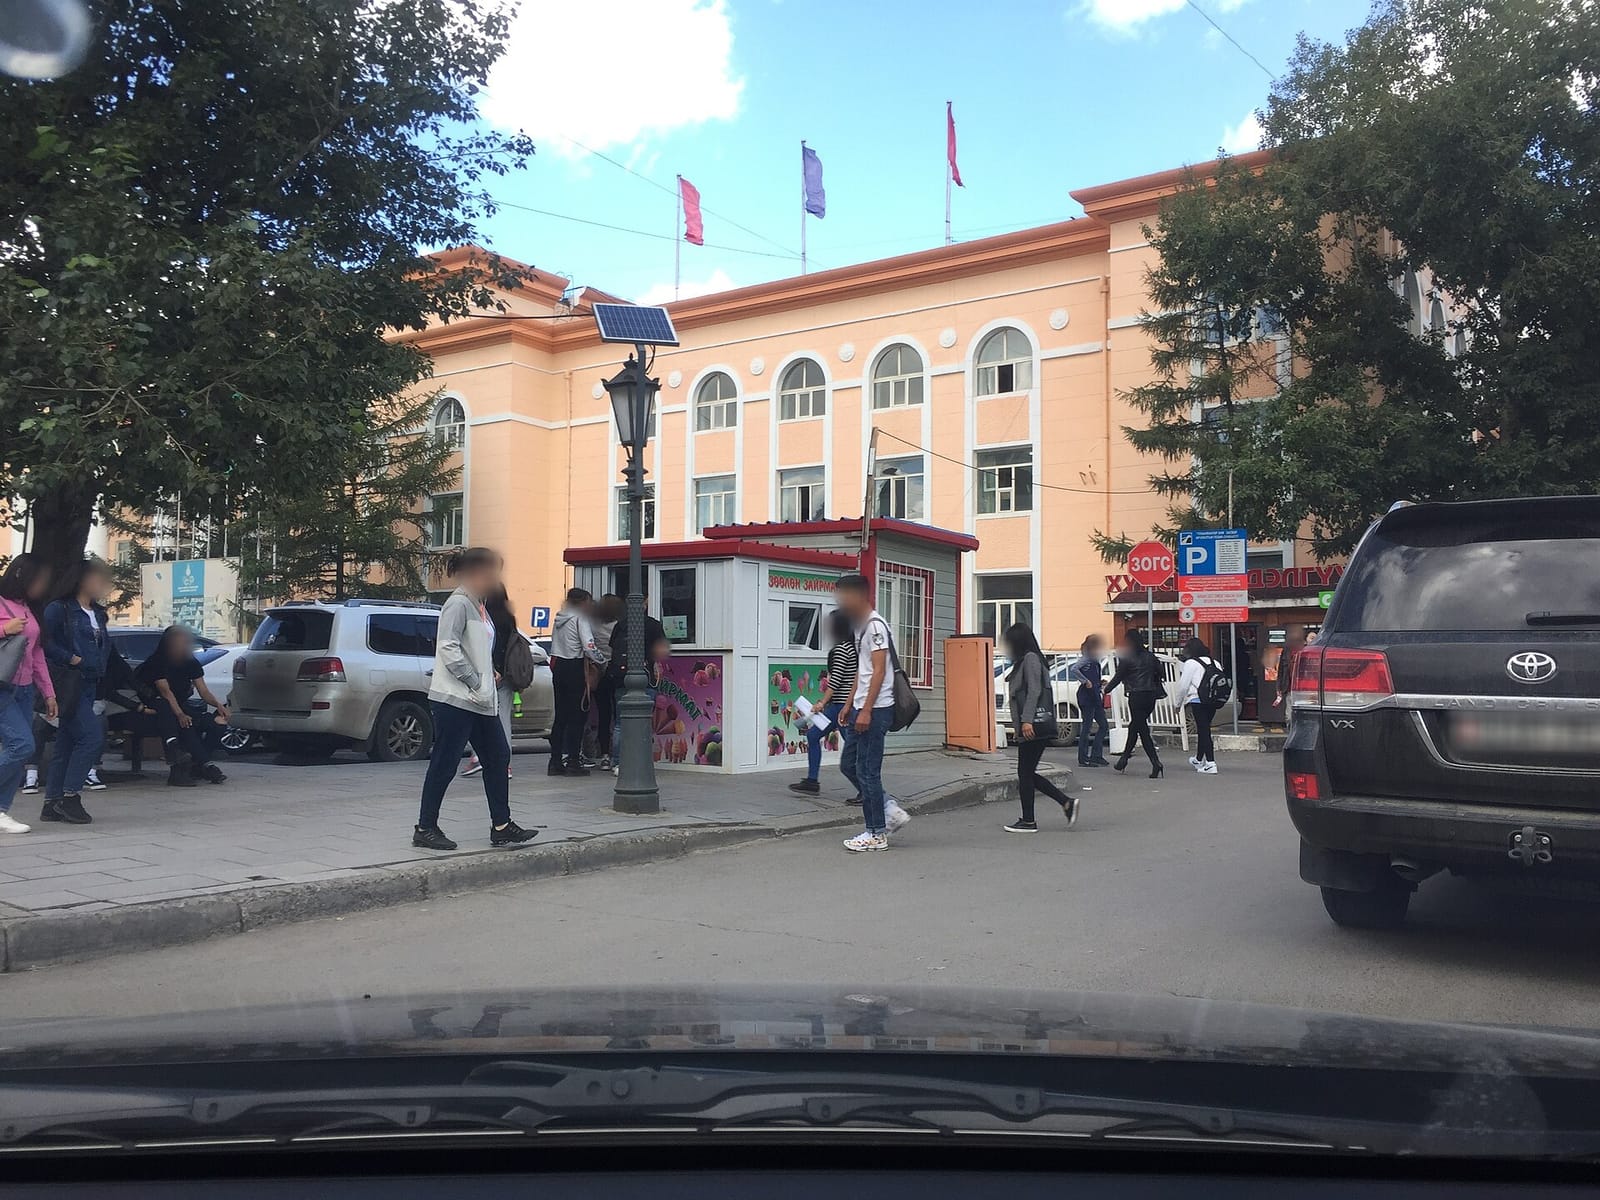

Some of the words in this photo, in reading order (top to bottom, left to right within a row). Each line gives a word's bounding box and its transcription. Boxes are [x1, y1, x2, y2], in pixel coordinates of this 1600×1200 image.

[1131, 556, 1171, 572] ЗОГС
[1187, 547, 1207, 574] P
[534, 609, 546, 626] P
[1330, 719, 1355, 729] VX
